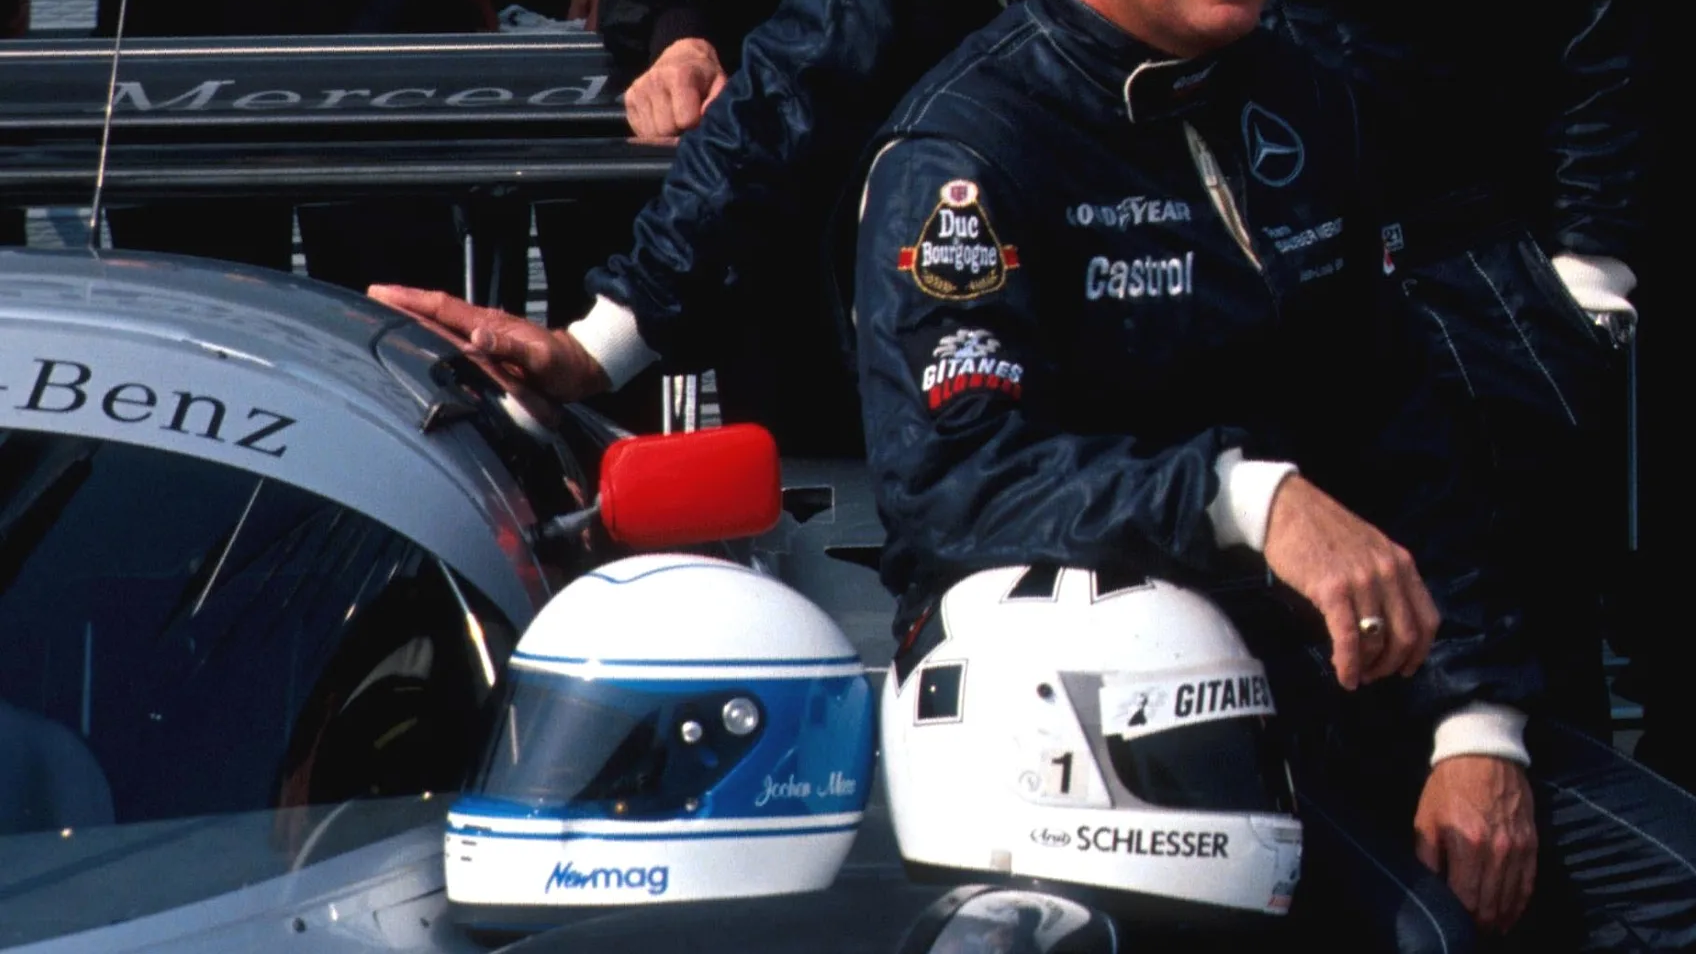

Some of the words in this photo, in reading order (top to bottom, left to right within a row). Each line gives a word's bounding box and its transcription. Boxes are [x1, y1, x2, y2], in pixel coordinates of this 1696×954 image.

[938, 208, 980, 239] Duc
[921, 240, 998, 275] Bourgogne
[1085, 250, 1196, 300] Castrol
[921, 356, 1024, 392] GITANES
[1051, 751, 1074, 795] 1
[1076, 824, 1230, 859] SCHLESSER
